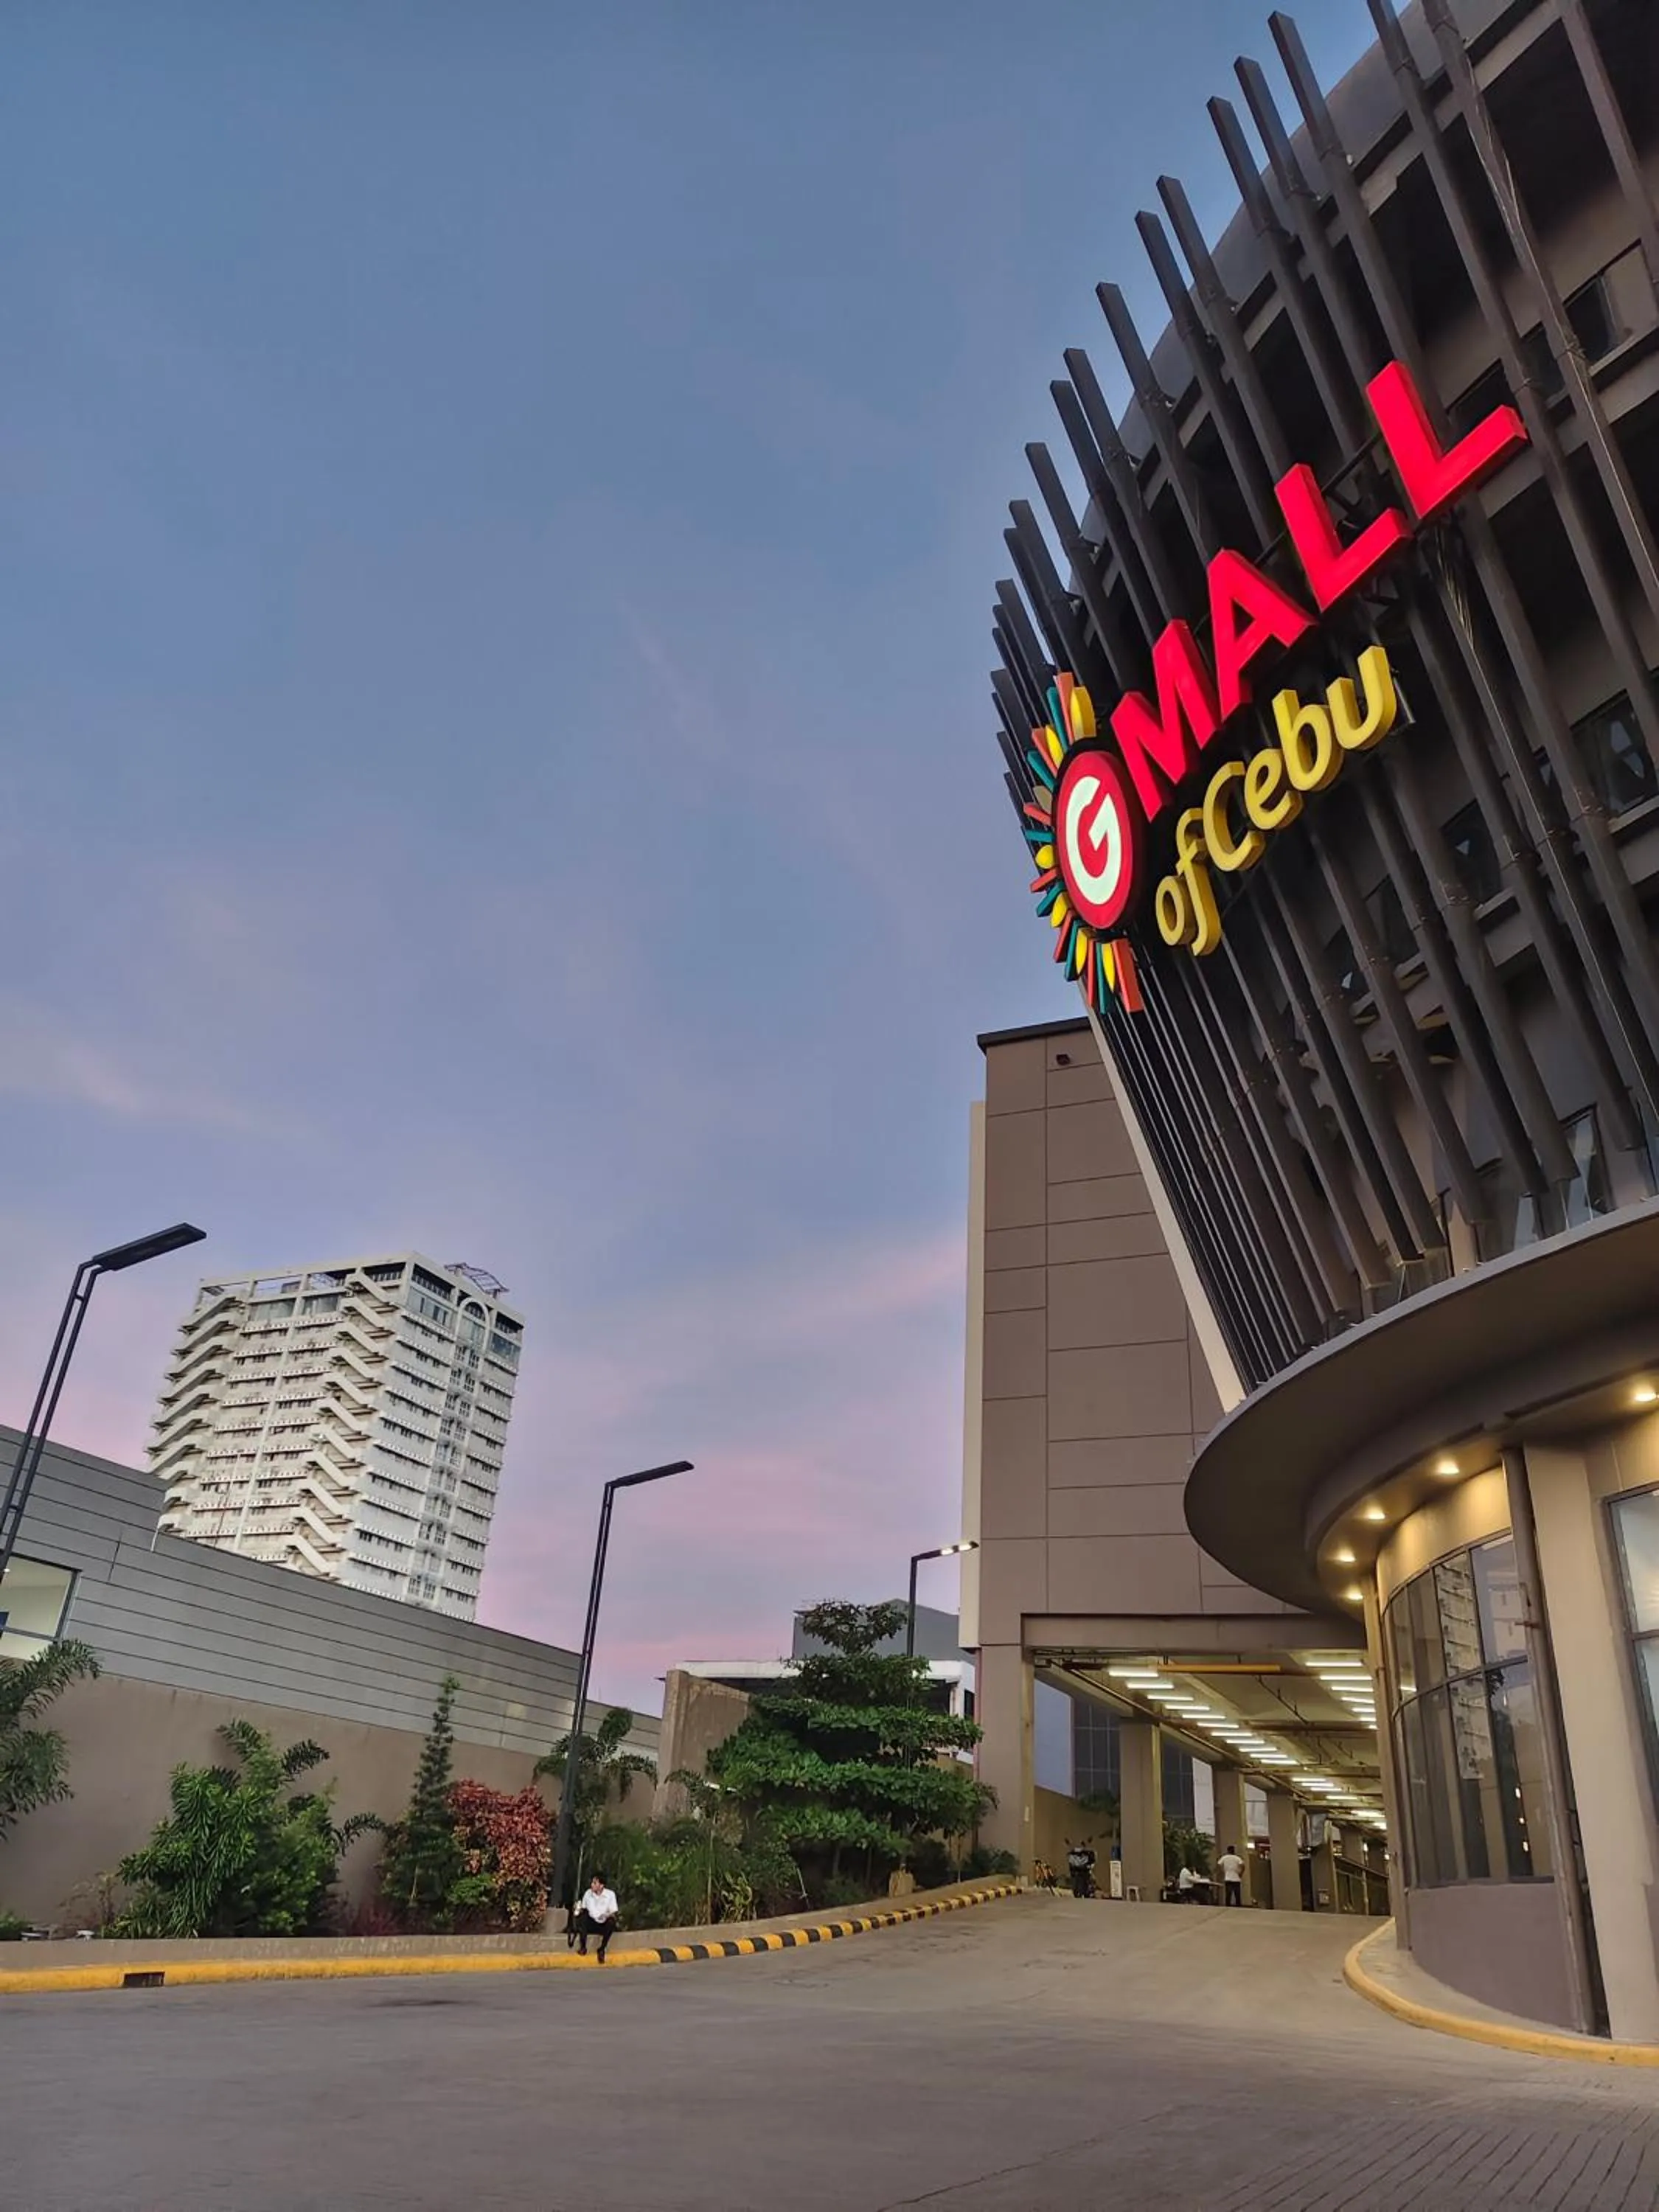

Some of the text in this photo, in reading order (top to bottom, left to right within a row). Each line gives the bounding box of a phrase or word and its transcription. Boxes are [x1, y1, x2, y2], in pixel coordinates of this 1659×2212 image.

[1066, 361, 1528, 905] G MALL
[1155, 645, 1398, 956] of Cebu
